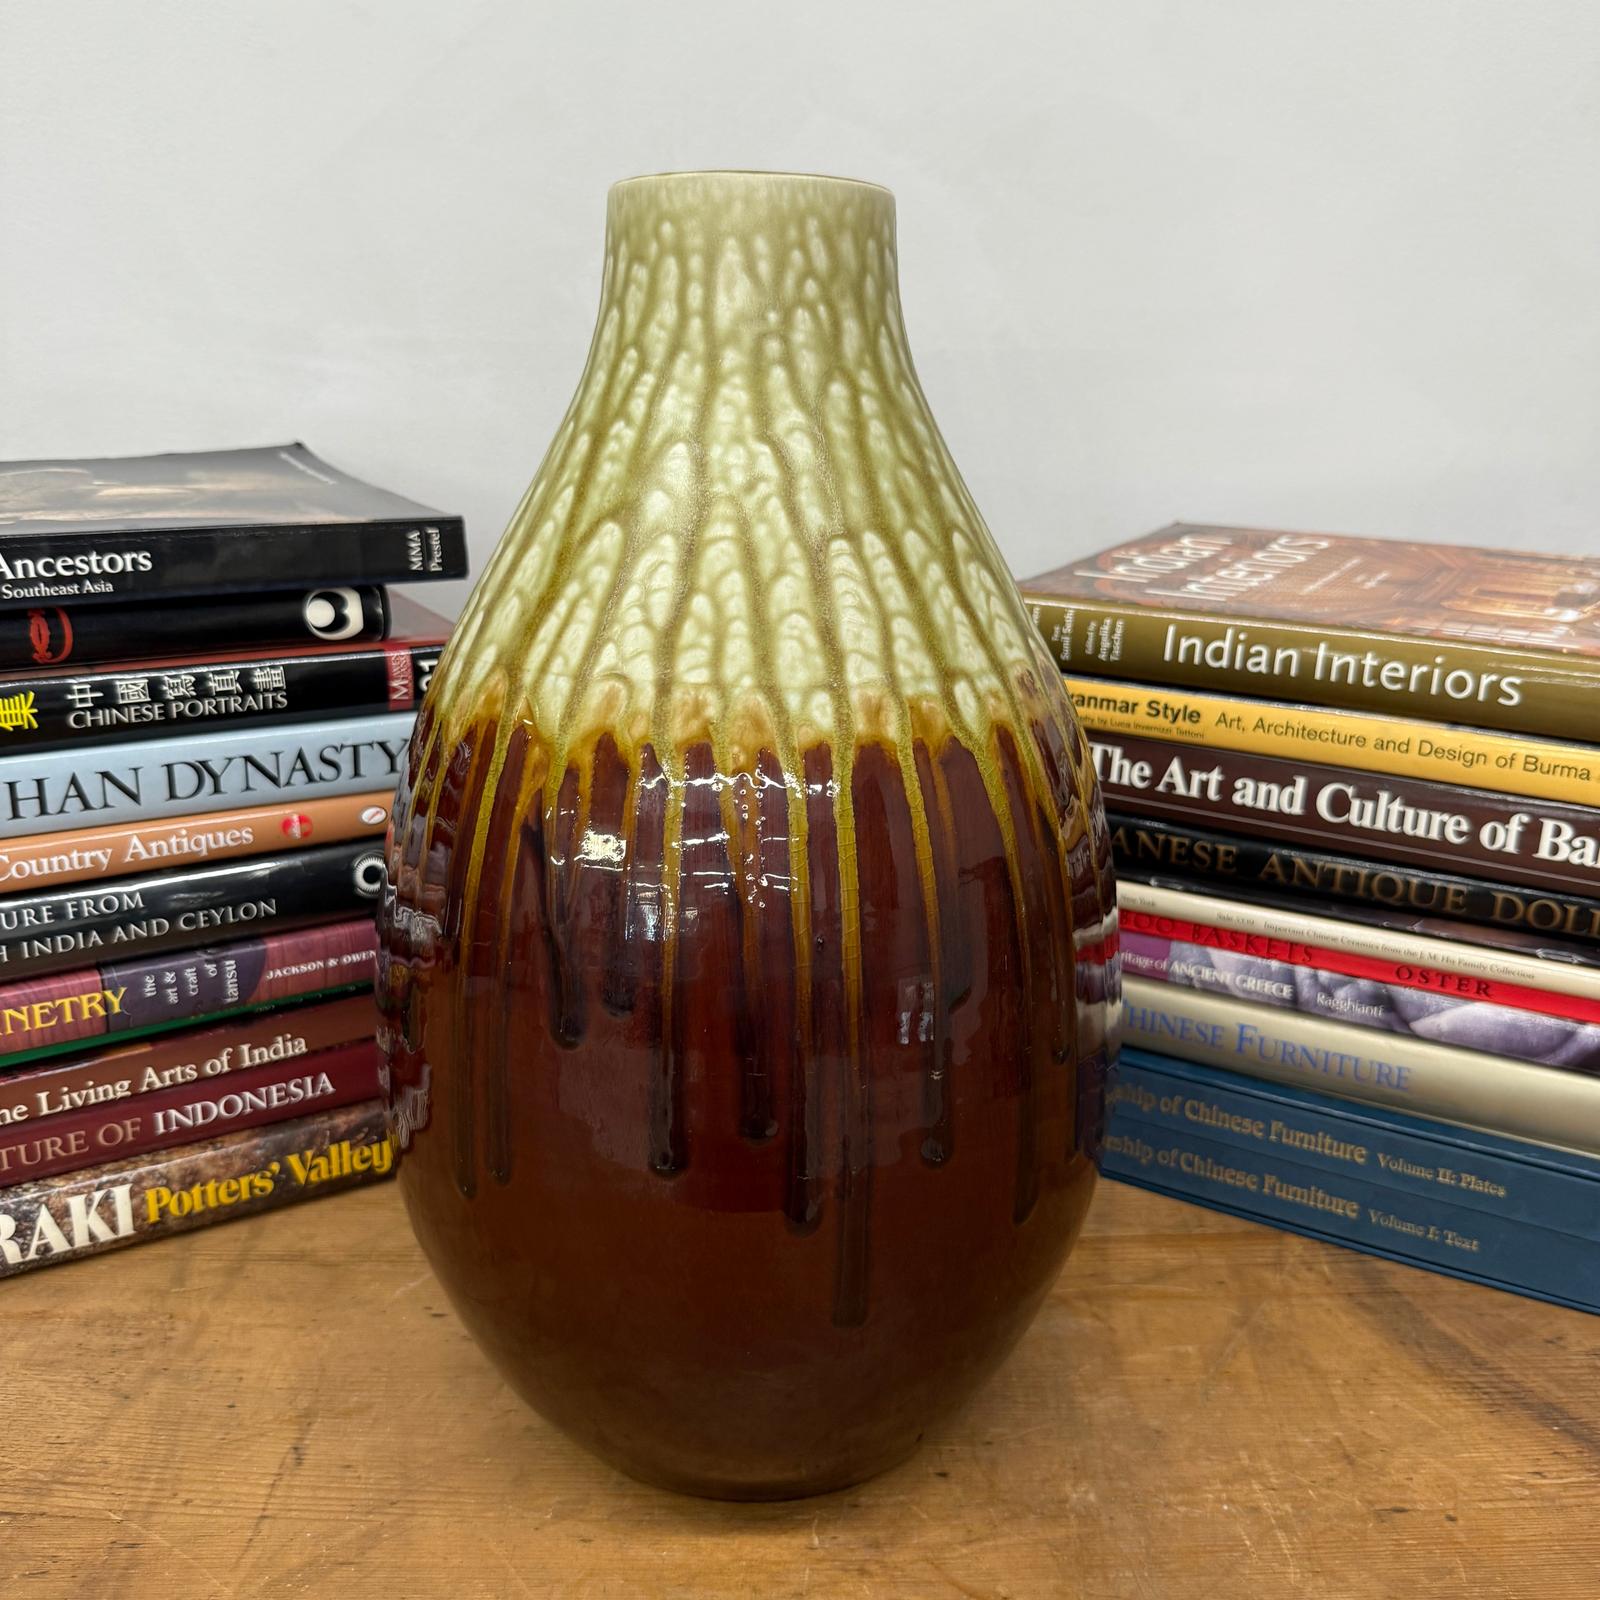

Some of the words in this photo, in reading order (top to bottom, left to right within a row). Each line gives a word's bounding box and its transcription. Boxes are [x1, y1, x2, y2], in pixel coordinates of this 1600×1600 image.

[407, 529, 424, 572] MMA
[426, 526, 443, 572] Prestel
[1, 582, 80, 600] Southeast
[82, 579, 115, 594] Asia
[1163, 623, 1300, 678] Indian
[1313, 641, 1524, 707] Interiors
[68, 702, 165, 729] CHINESE
[172, 691, 289, 719] PORTRAITS
[1146, 699, 1202, 725] Style
[1215, 711, 1247, 732] Art,
[1252, 716, 1367, 749] Architecture
[1373, 728, 1411, 756] and
[1417, 738, 1488, 768] Design
[1495, 751, 1516, 769] of
[1522, 754, 1592, 781] Burma
[5, 766, 145, 820] HAN
[161, 737, 410, 802] DYNASTY
[1087, 741, 1153, 789] The
[1155, 755, 1225, 801] Art
[1231, 775, 1306, 816] and
[1316, 781, 1472, 845] Culture
[1479, 812, 1534, 854] of
[1532, 818, 1600, 868] Ba
[0, 845, 112, 882] Country
[123, 823, 255, 864] Antiques
[1258, 852, 1470, 914] ANTIQUE
[1, 904, 55, 931] URE
[66, 891, 146, 920] FROM
[21, 929, 105, 959] INDIA
[112, 916, 171, 944] AND
[178, 899, 278, 931] CEYLON
[1191, 922, 1314, 963] BASKETS
[1263, 920, 1304, 936] Important
[1381, 943, 1401, 955] from
[1458, 956, 1487, 971] Family
[1489, 962, 1536, 980] Collection
[144, 974, 157, 998] the
[163, 970, 177, 985] &
[185, 966, 198, 997] craft
[204, 962, 218, 978] of
[224, 959, 240, 1004] tansu
[266, 958, 325, 980] JACKSON
[328, 957, 340, 968] &
[1155, 956, 1169, 970] of
[1170, 960, 1232, 984] ANCIENT
[1235, 975, 1295, 999] GREECE
[1395, 964, 1494, 997] OSTER
[167, 986, 179, 1005] art
[36, 1079, 132, 1116] Living
[140, 1062, 199, 1094] Arts
[201, 1047, 233, 1078] of
[238, 1032, 308, 1069] India
[1235, 1022, 1413, 1092] FURNITURE
[98, 1116, 142, 1146] OF
[152, 1071, 337, 1136] INDONESIA
[1159, 1094, 1184, 1115] of
[1184, 1099, 1266, 1138] Chinese
[1269, 1119, 1368, 1165] Furniture
[1377, 1151, 1434, 1180] Volume
[1436, 1166, 1457, 1186] II:
[1458, 1172, 1508, 1198] Plates
[0, 1182, 137, 1266] RAKI
[286, 1139, 394, 1187] Valley
[1157, 1147, 1181, 1167] of
[1180, 1152, 1259, 1191] Chinese
[1263, 1173, 1360, 1220] Furniture
[1367, 1207, 1425, 1237] Volume
[1443, 1229, 1480, 1252] Text
